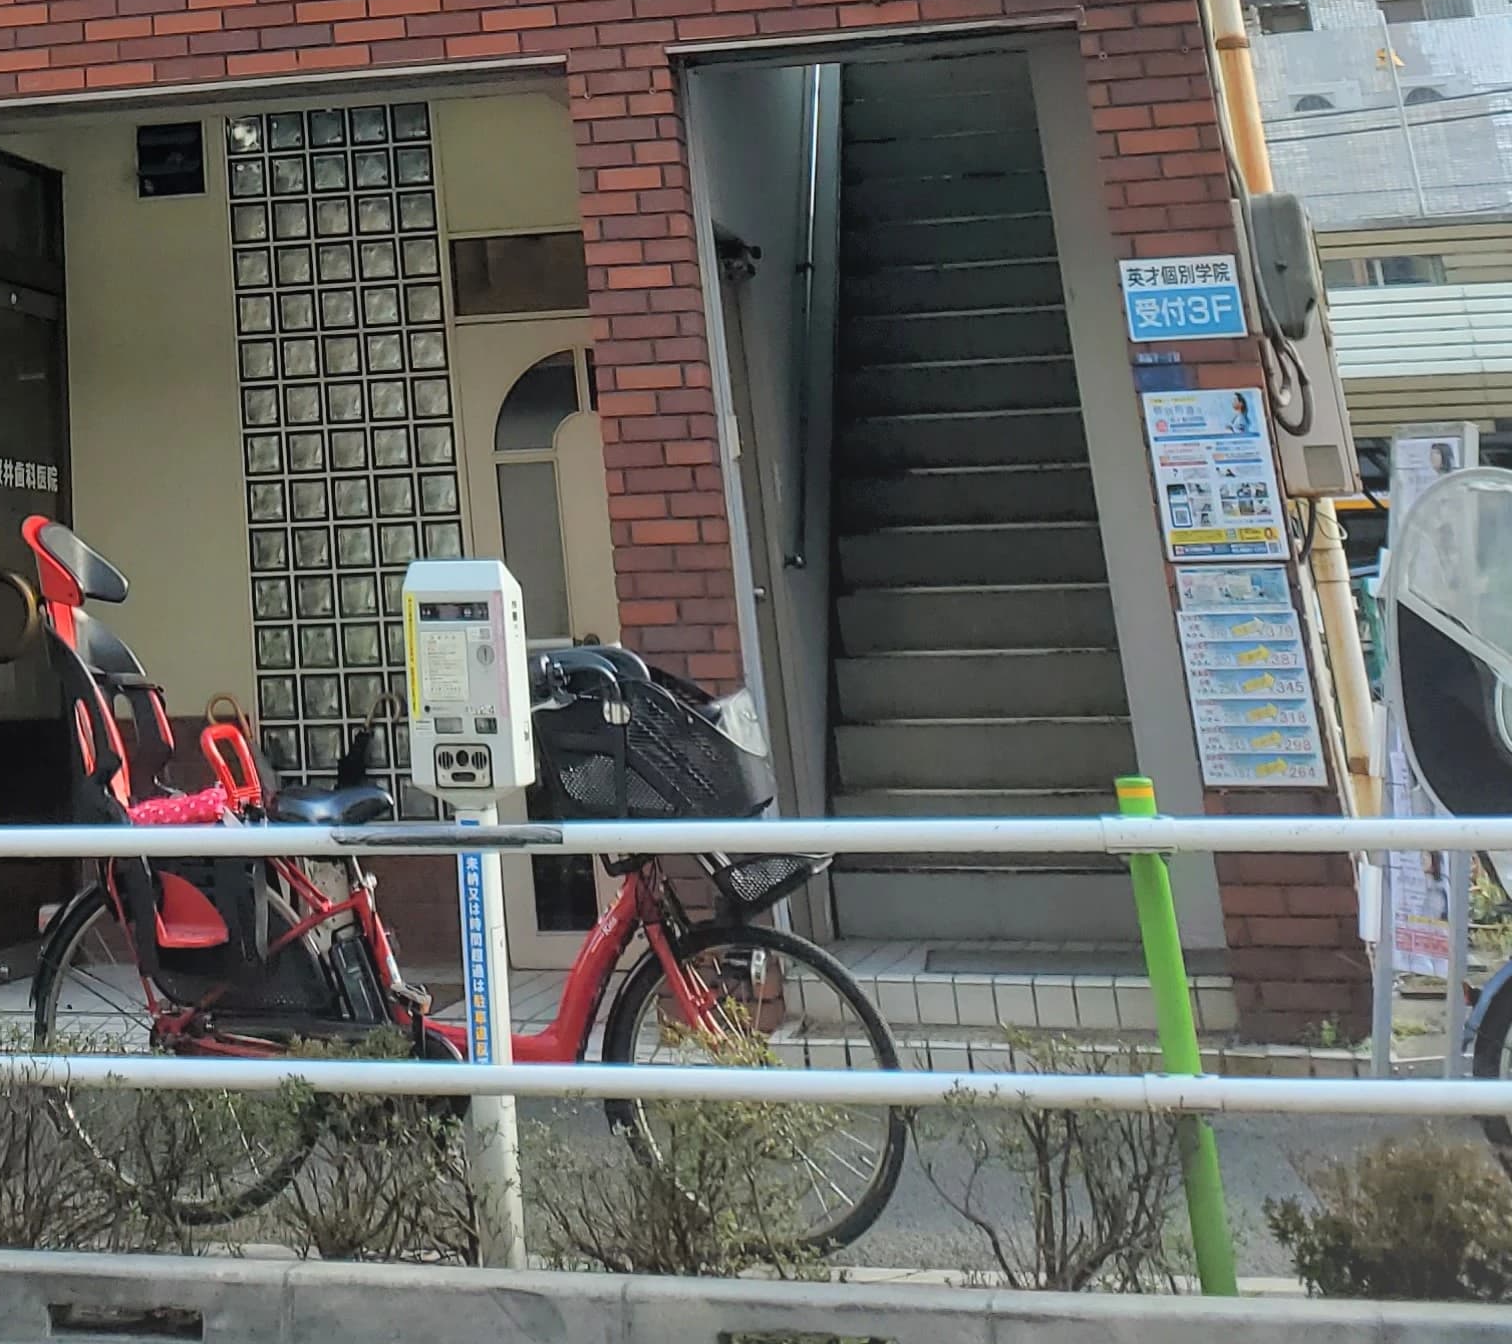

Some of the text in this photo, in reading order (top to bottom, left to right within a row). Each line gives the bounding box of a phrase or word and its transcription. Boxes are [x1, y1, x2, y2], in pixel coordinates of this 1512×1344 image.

[1126, 263, 1231, 287] 英才個別学院
[1135, 294, 1232, 328] 受付3F
